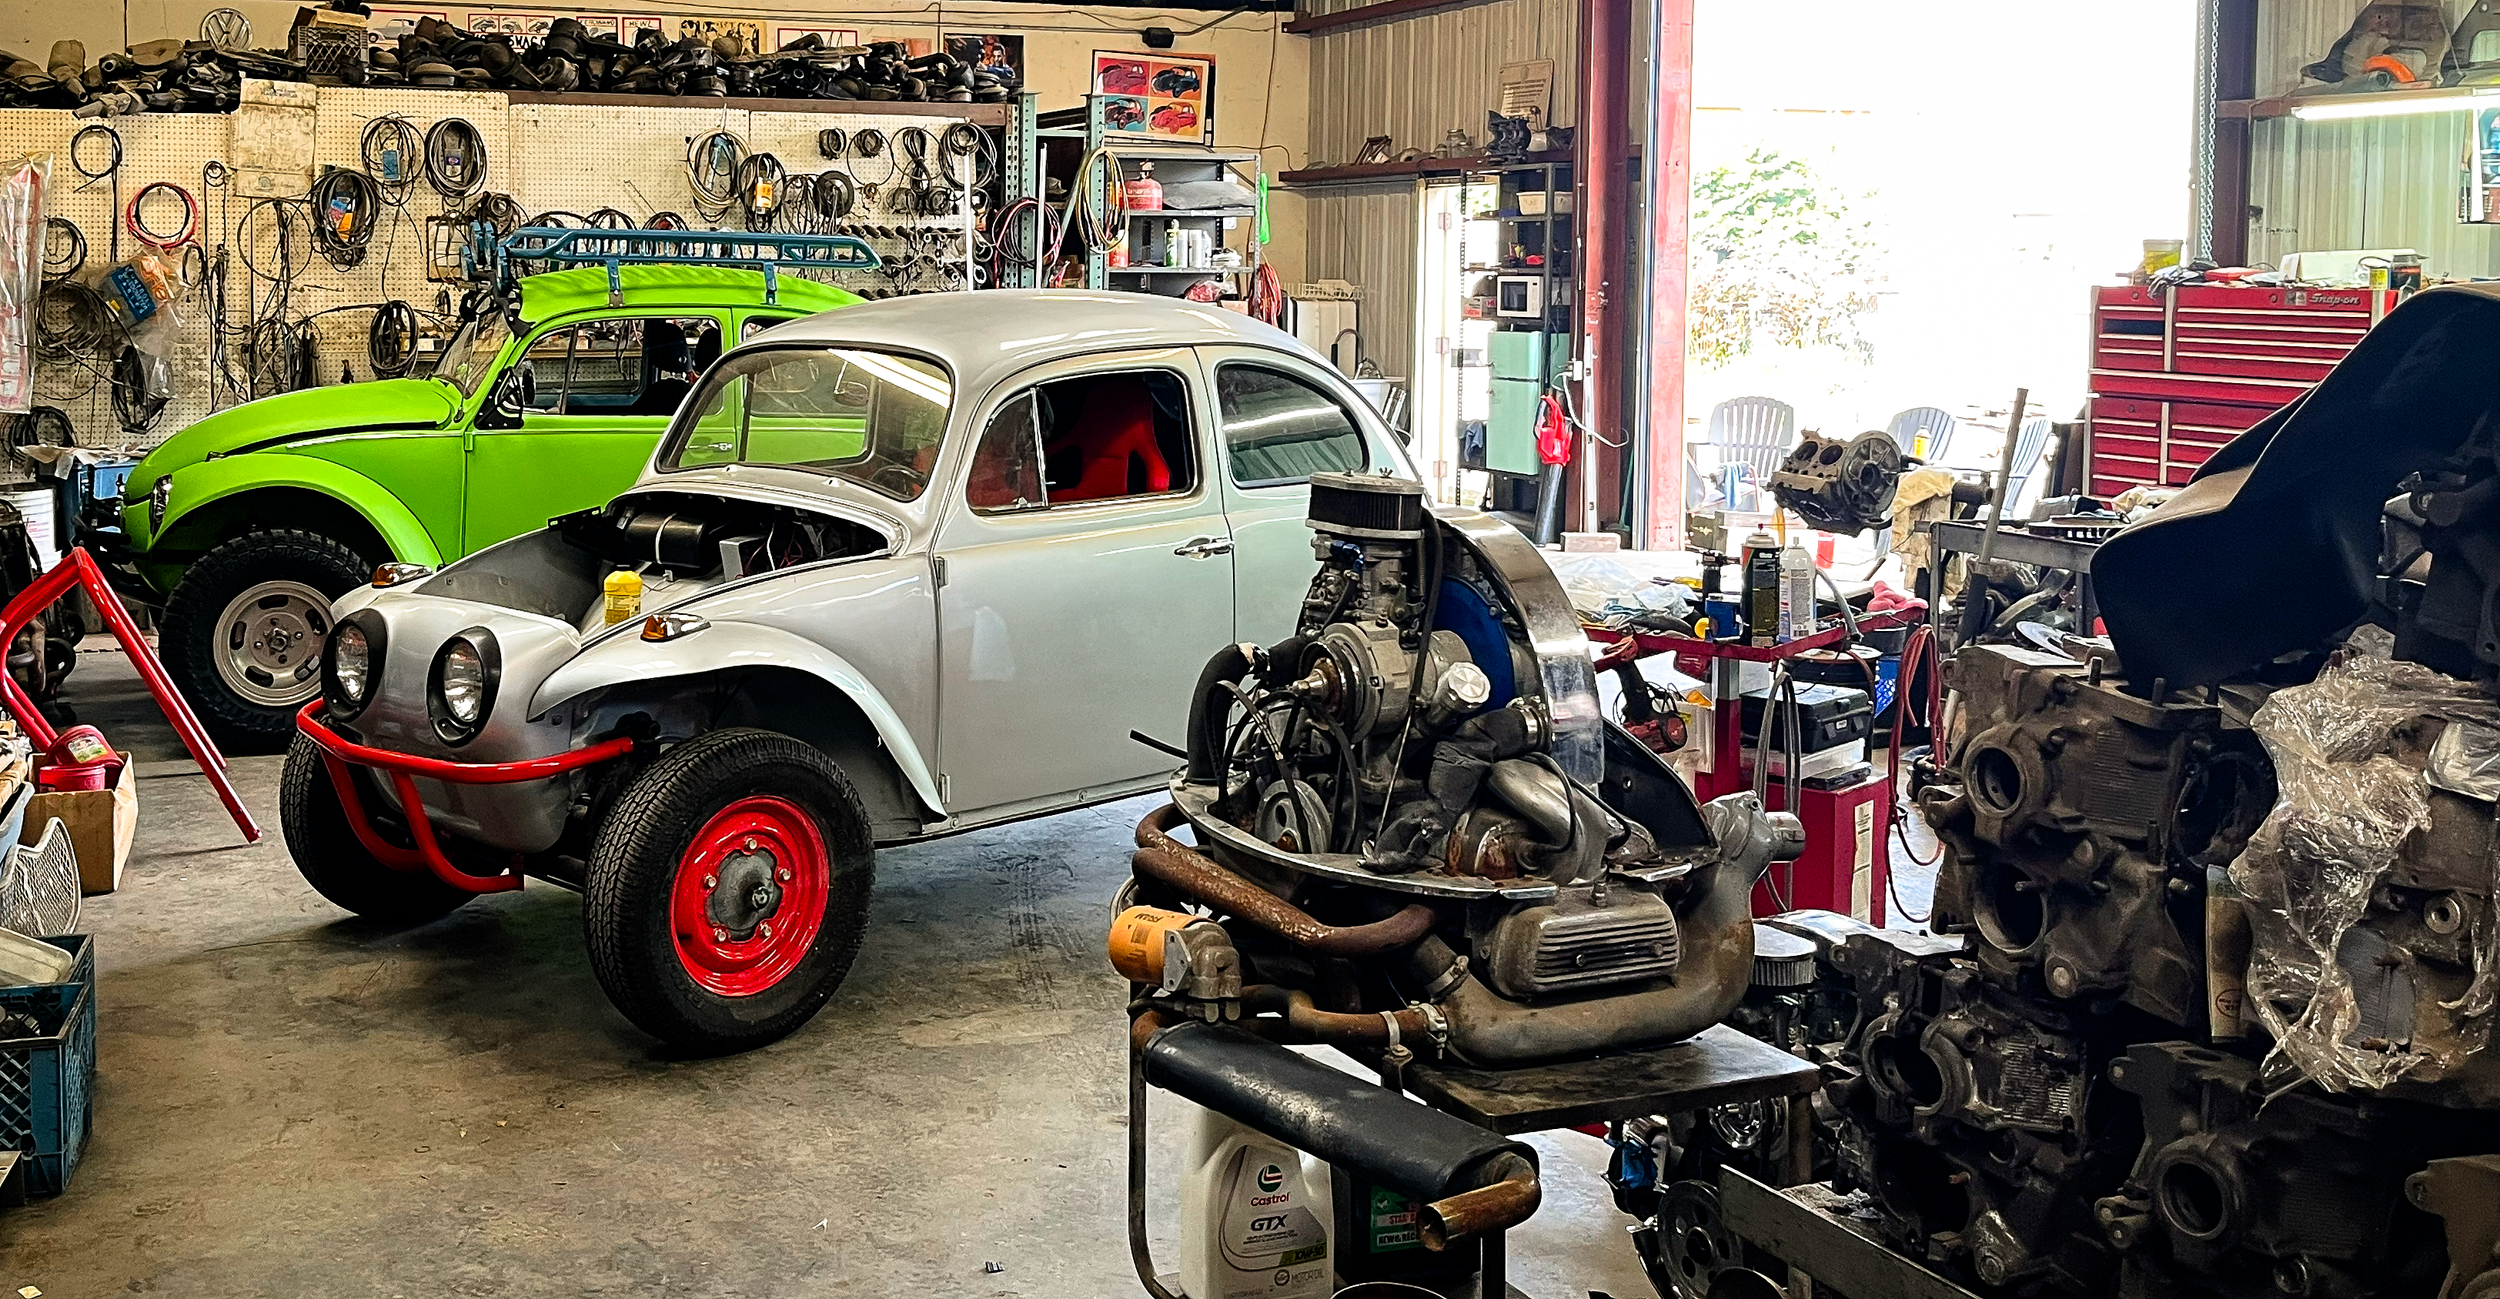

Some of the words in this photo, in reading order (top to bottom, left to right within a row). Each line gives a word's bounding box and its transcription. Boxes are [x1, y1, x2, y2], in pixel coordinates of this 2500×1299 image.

[2310, 293, 2361, 306] Snap-on
[1250, 1191, 1291, 1207] Castrol
[1250, 1213, 1289, 1231] GTX
